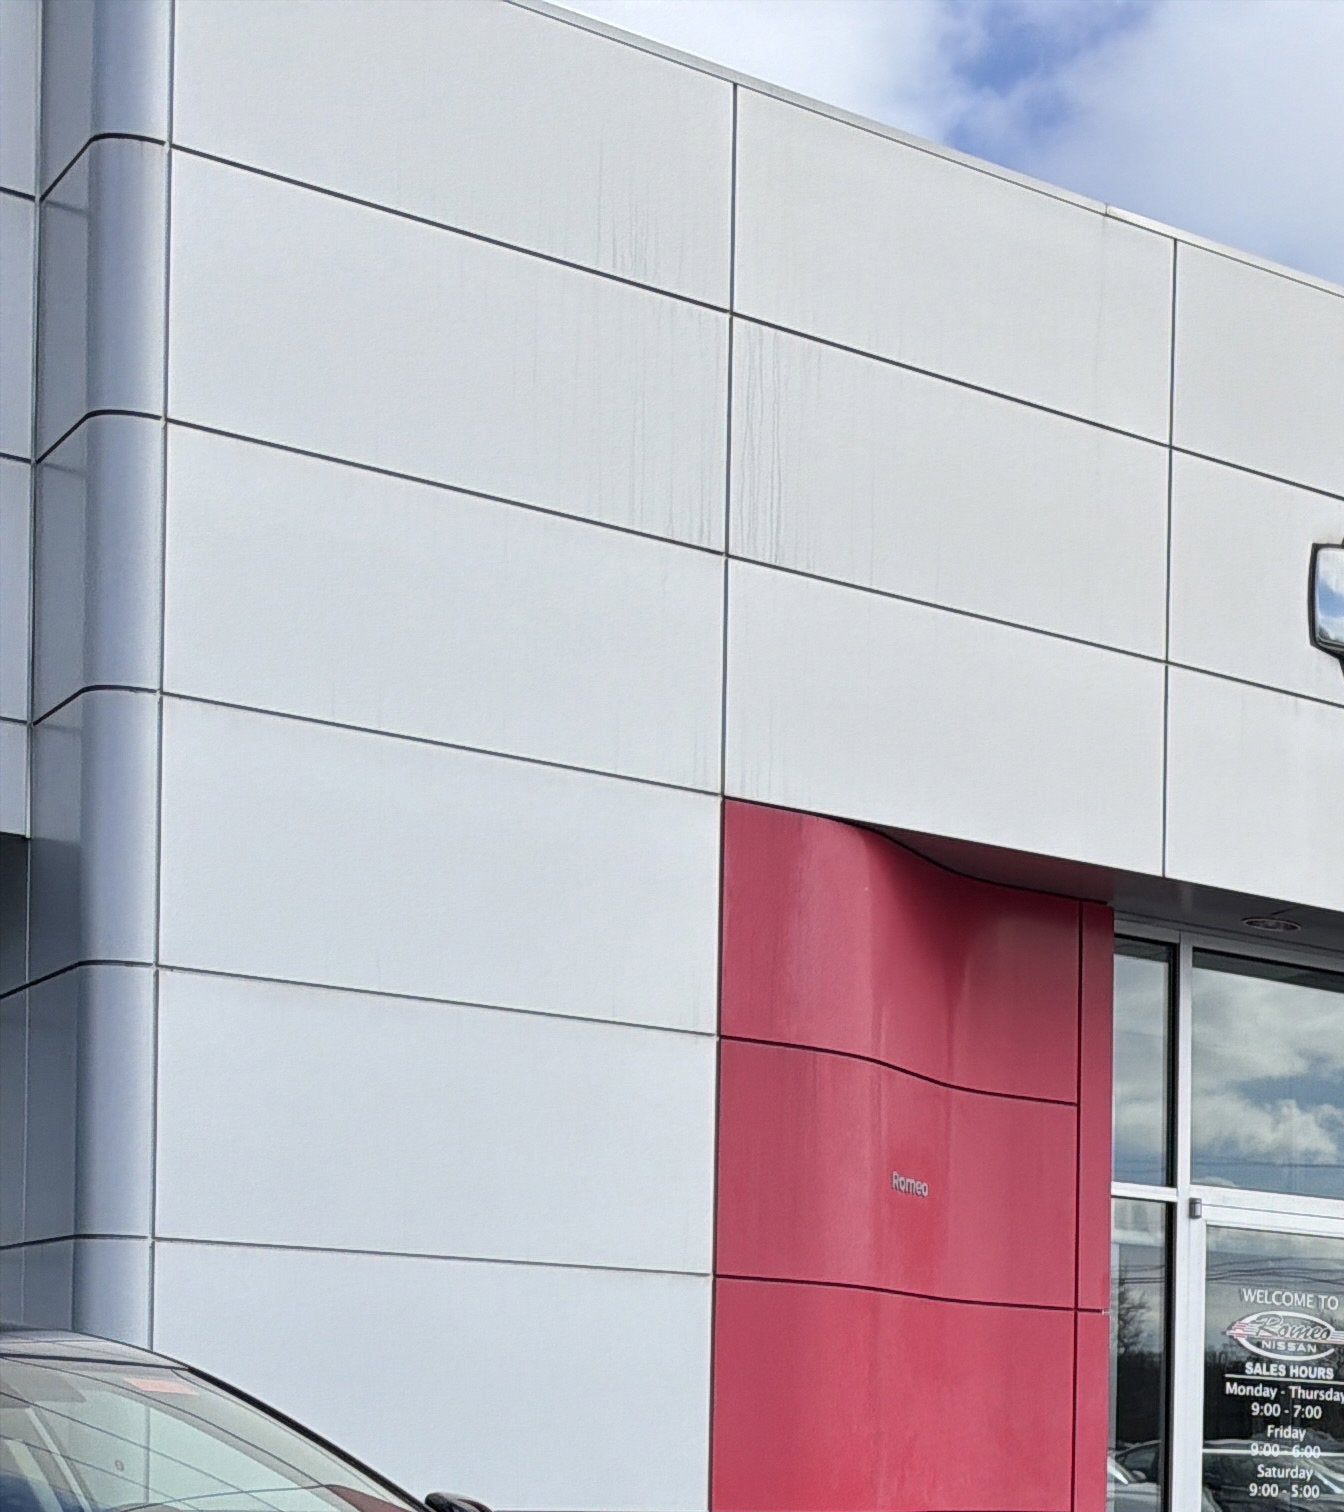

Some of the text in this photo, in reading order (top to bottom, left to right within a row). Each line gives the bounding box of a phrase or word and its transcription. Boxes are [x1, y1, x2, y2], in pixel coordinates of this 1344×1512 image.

[892, 1170, 929, 1197] Romeo
[1242, 1288, 1339, 1310] WELCOME TO
[1254, 1314, 1331, 1340] Romeo
[1261, 1340, 1317, 1353] NISSAN
[1245, 1362, 1335, 1380] SALES HOURS
[1225, 1382, 1278, 1400] Monday
[1251, 1402, 1281, 1417] 9:00
[1293, 1405, 1323, 1419] 7:00
[1267, 1425, 1307, 1442] Friday
[1250, 1443, 1280, 1457] 9:00
[1292, 1445, 1321, 1459] 6:00
[1257, 1464, 1314, 1482] Saturday
[1249, 1483, 1279, 1497] 9:00
[1291, 1484, 1320, 1499] 5:00
